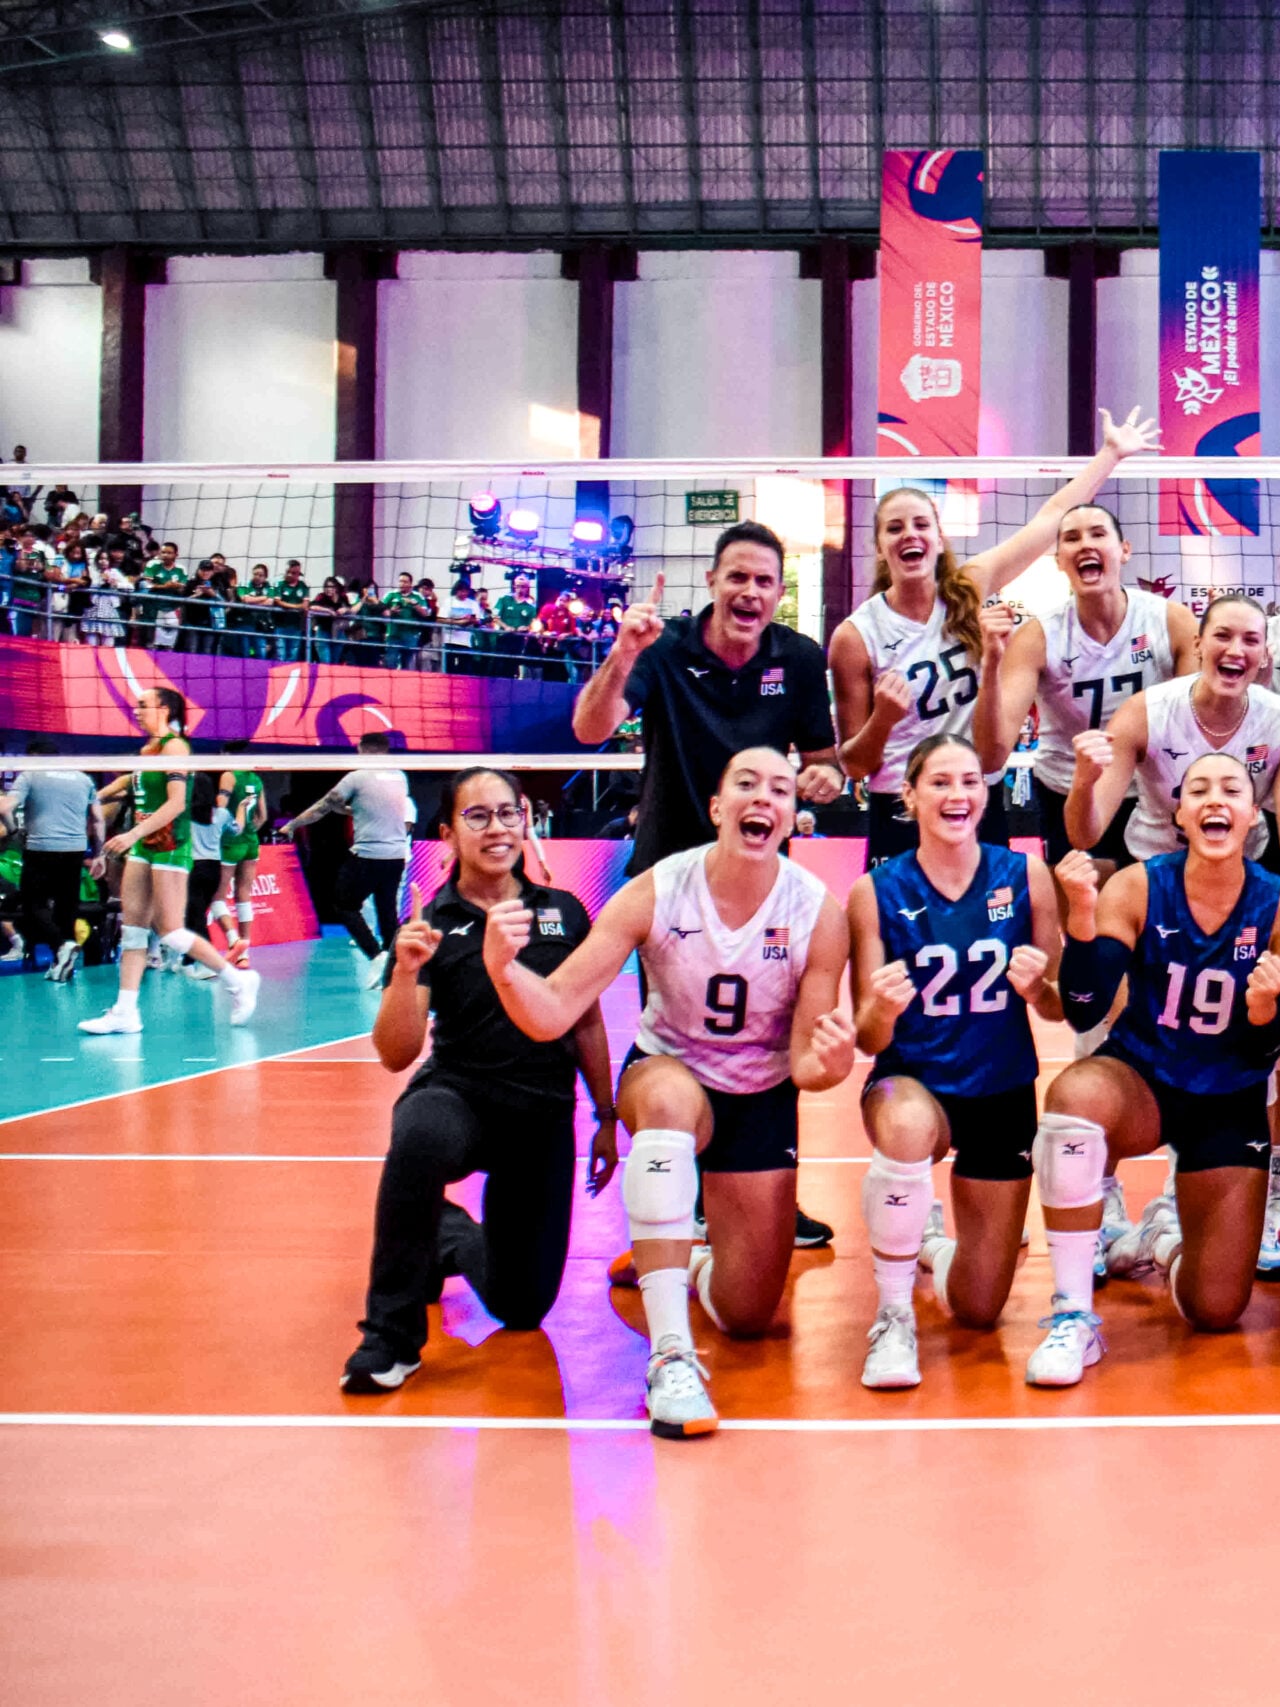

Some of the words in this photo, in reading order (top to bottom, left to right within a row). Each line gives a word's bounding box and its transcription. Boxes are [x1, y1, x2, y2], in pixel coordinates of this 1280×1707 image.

[913, 282, 922, 299] DEL
[925, 282, 936, 298] DE
[1185, 281, 1197, 300] DE
[913, 300, 922, 347] GOBIERNO
[925, 300, 936, 347] ESTADO
[936, 281, 954, 347] MÉXICO
[1185, 301, 1197, 353] ESTADO
[1199, 281, 1221, 375] MÉXICO
[1223, 319, 1238, 334] de
[1190, 587, 1245, 597] ESADO
[1248, 587, 1265, 597] DE
[1131, 649, 1154, 664] USA
[760, 682, 785, 696] USA
[907, 642, 979, 721] 25
[988, 905, 1014, 923] USA
[539, 922, 565, 936] USA
[763, 945, 789, 961] USA
[915, 937, 1008, 1017] 22
[704, 973, 749, 1036] 9
[1157, 961, 1235, 1035] 19
